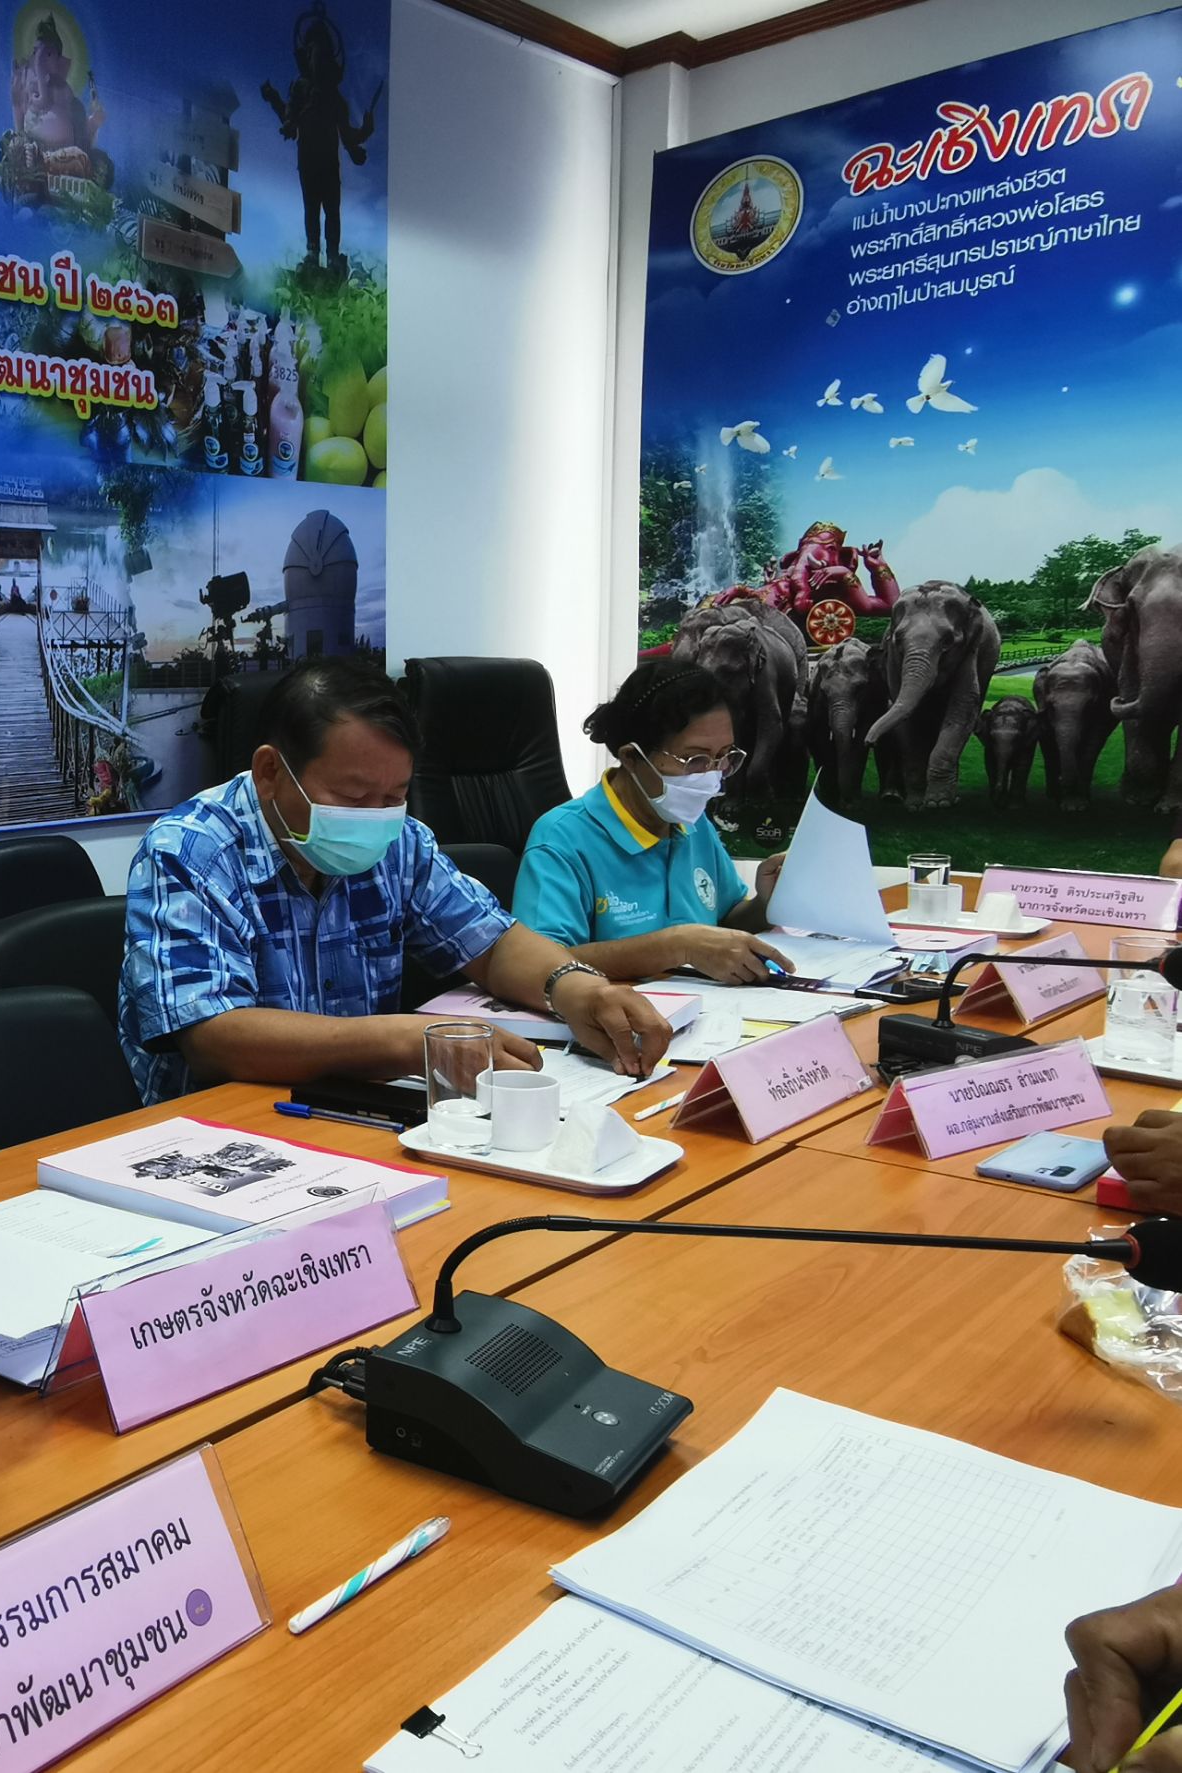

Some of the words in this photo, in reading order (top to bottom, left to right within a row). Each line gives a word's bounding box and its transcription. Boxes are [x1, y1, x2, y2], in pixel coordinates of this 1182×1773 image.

[843, 73, 1153, 196] ฉะเชิงเทรา
[852, 168, 1066, 231] แม่น้ำบางปะกงแหล่งชีวิต
[56, 258, 80, 310] ปี
[90, 282, 177, 323] ๒๕๖๓
[130, 1242, 373, 1350] เกษตรจังหวัดฉะเชิงเทรา
[396, 1336, 428, 1357] NPE
